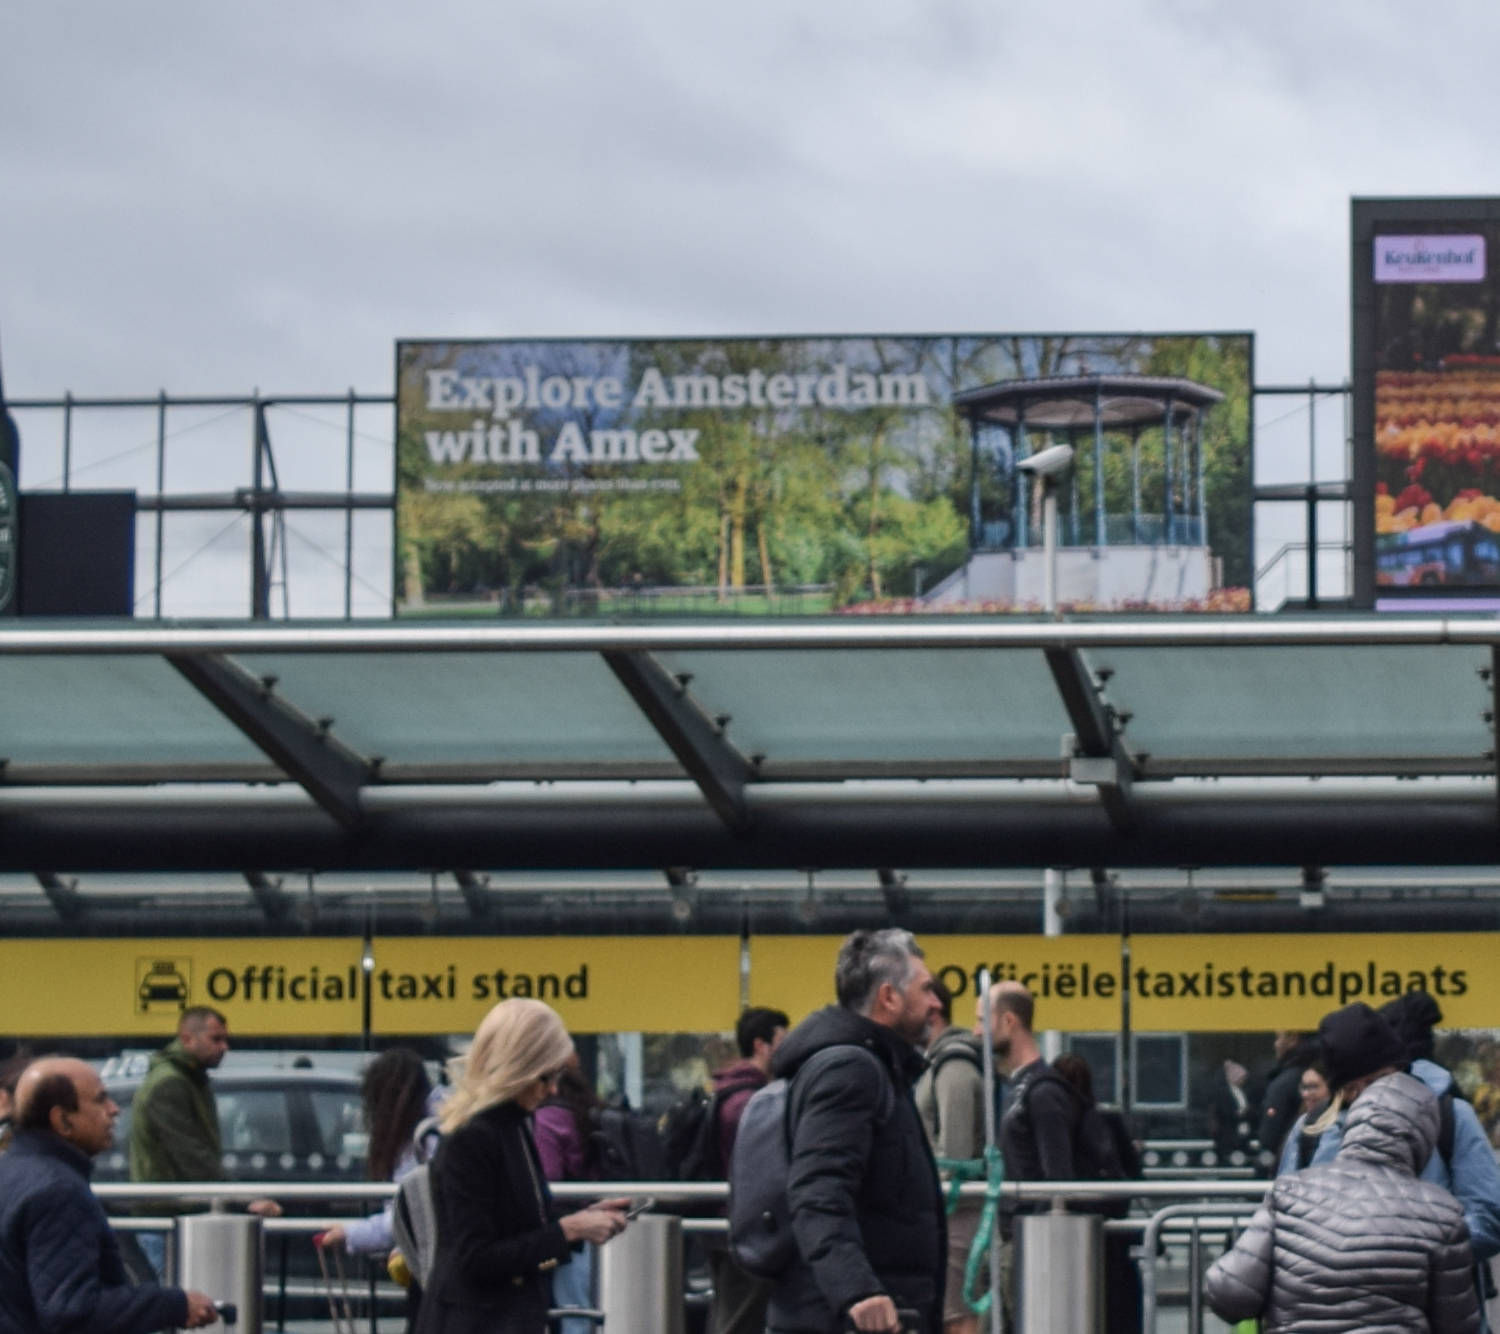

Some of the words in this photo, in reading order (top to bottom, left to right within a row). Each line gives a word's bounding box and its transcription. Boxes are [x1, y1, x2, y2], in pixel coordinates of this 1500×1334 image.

[425, 367, 622, 417] Explore
[633, 367, 927, 407] Amsterdam
[426, 421, 539, 462] with
[551, 422, 700, 462] Amex
[206, 966, 357, 1001] Official
[380, 967, 455, 1000] taxi
[472, 965, 590, 1000] stand
[1135, 961, 1469, 1005] taxistandplaats
